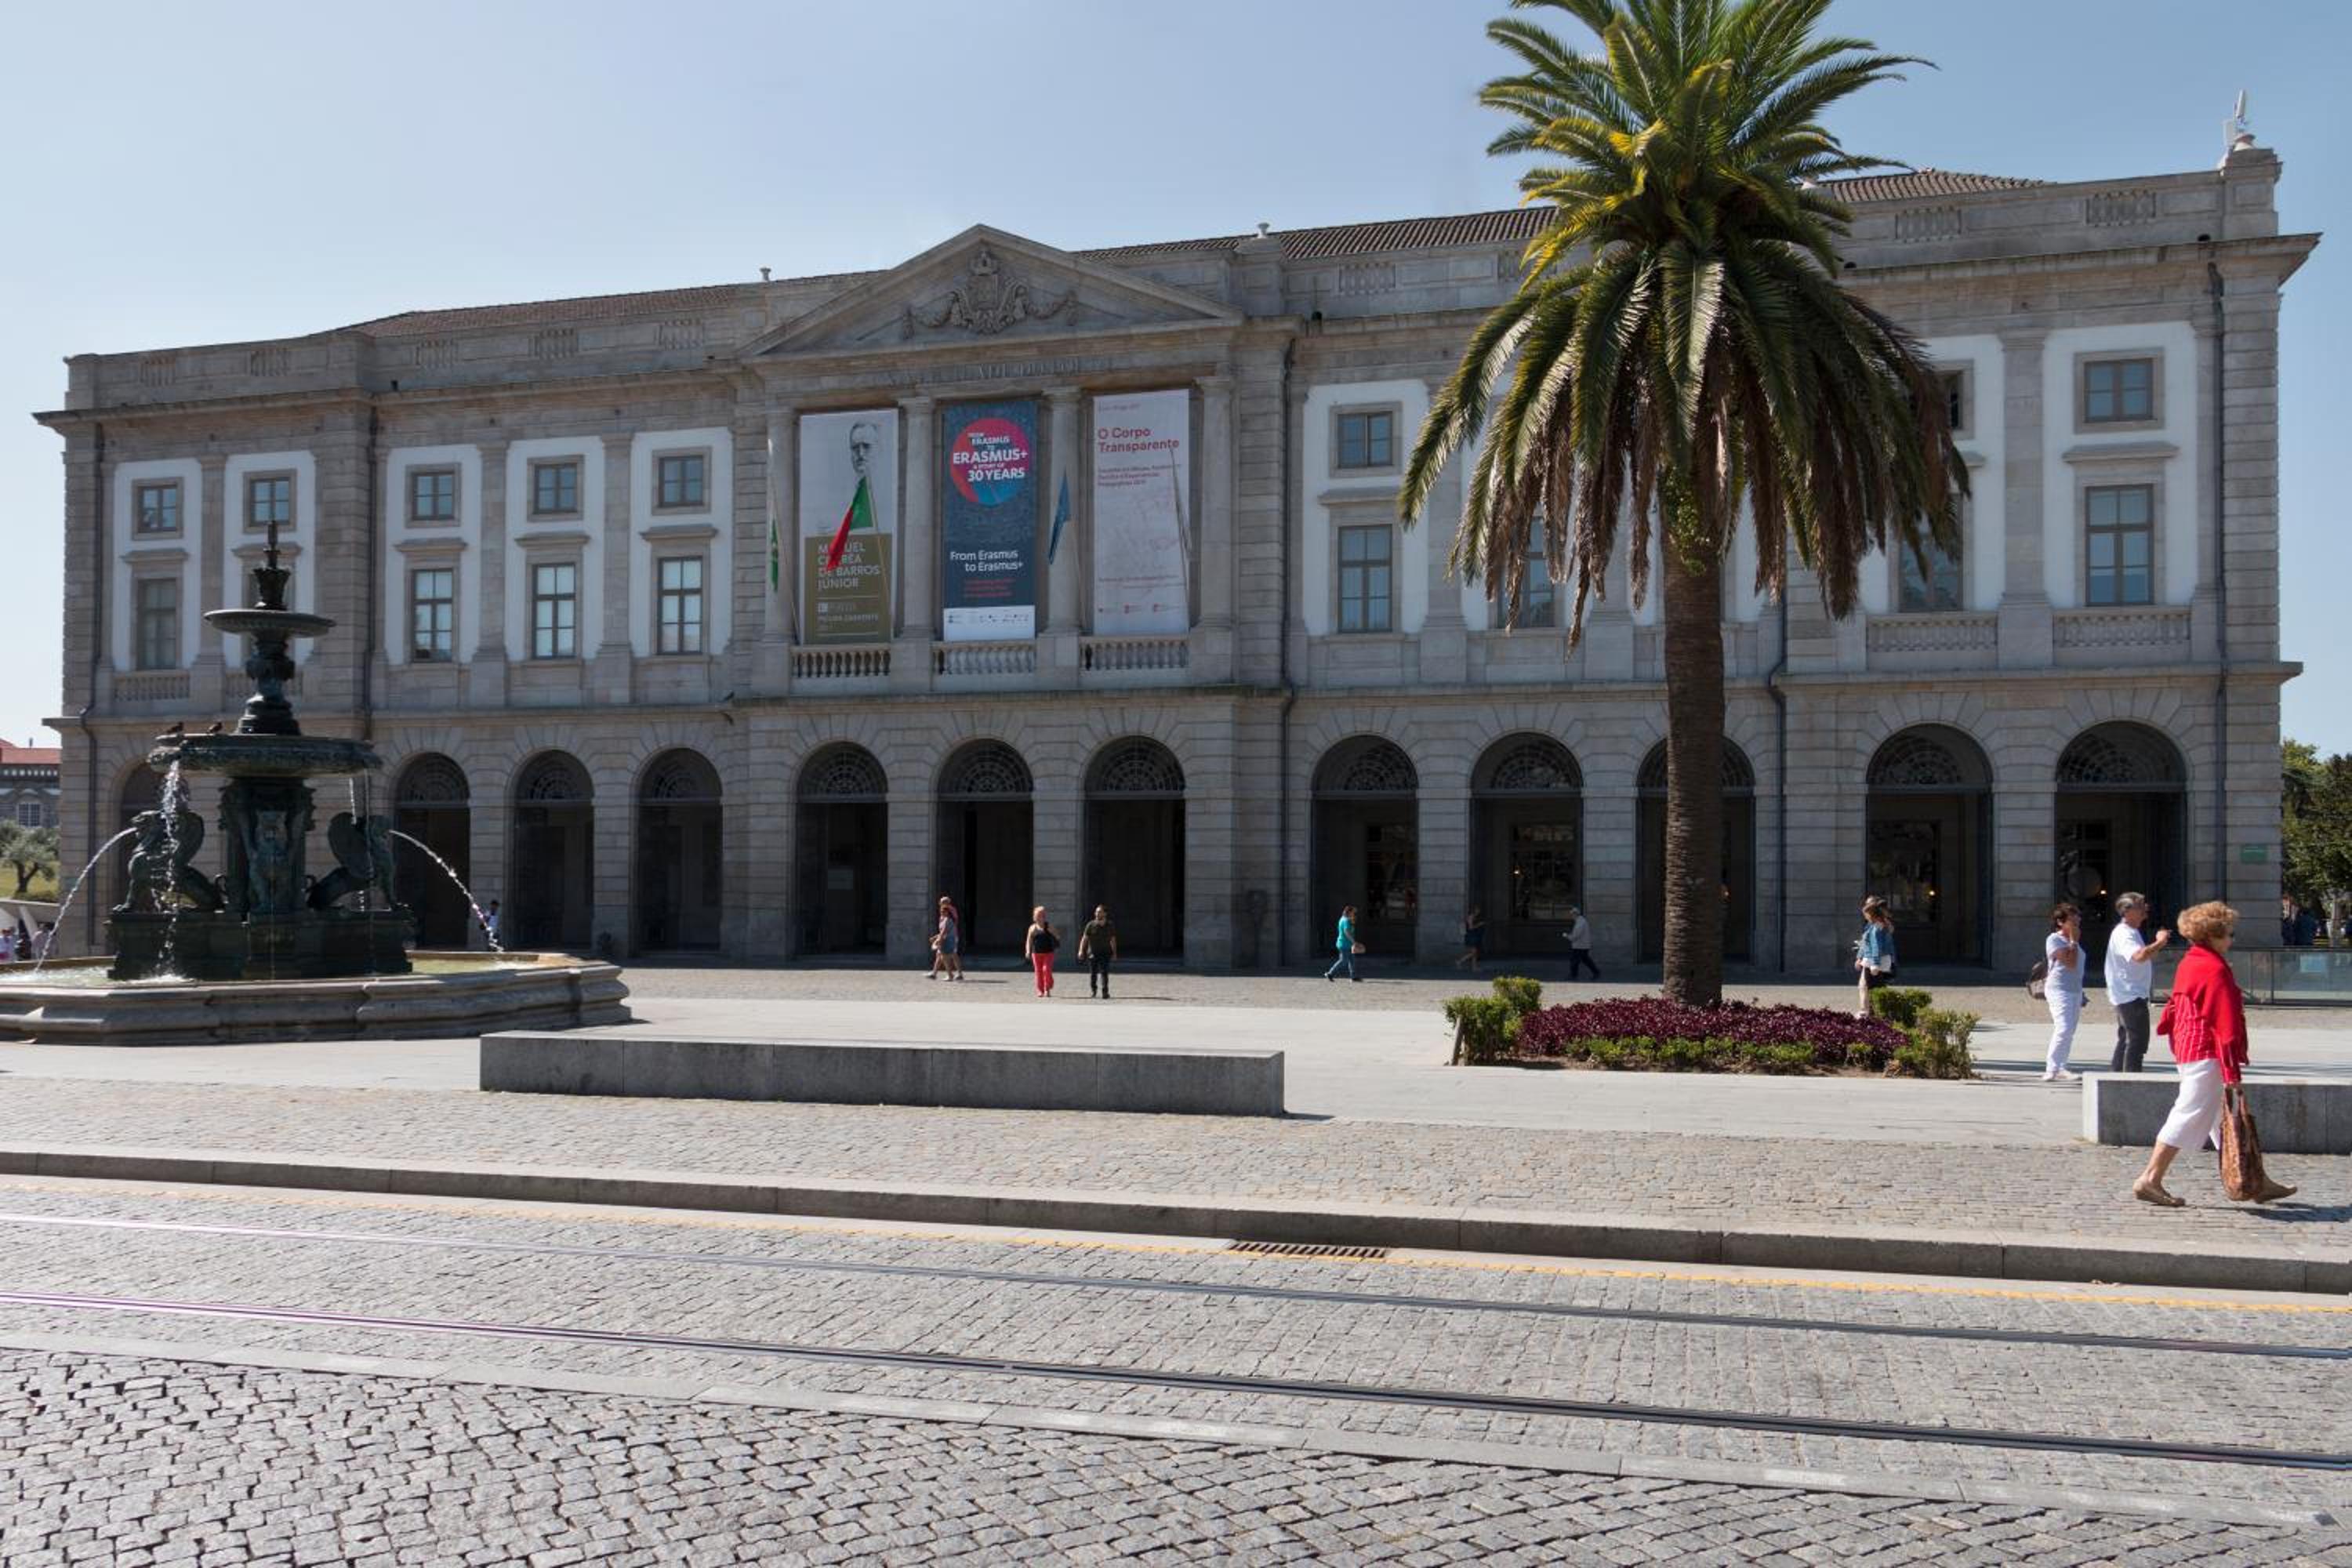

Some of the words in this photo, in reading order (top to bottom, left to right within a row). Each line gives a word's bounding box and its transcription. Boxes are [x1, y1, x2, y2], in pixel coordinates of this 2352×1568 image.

[1098, 428, 1108, 439] O
[1112, 427, 1151, 439] Corpo
[1099, 439, 1180, 453] Transparente
[953, 448, 1028, 464] ERASMUS+
[967, 470, 984, 482] 30
[985, 467, 1025, 481] YEARS
[818, 541, 866, 554] MUEL
[950, 551, 976, 561] From
[978, 550, 1018, 561] Erasmus
[836, 564, 880, 577] BARROS
[965, 562, 976, 572] to
[978, 561, 1023, 572] Erasmus+
